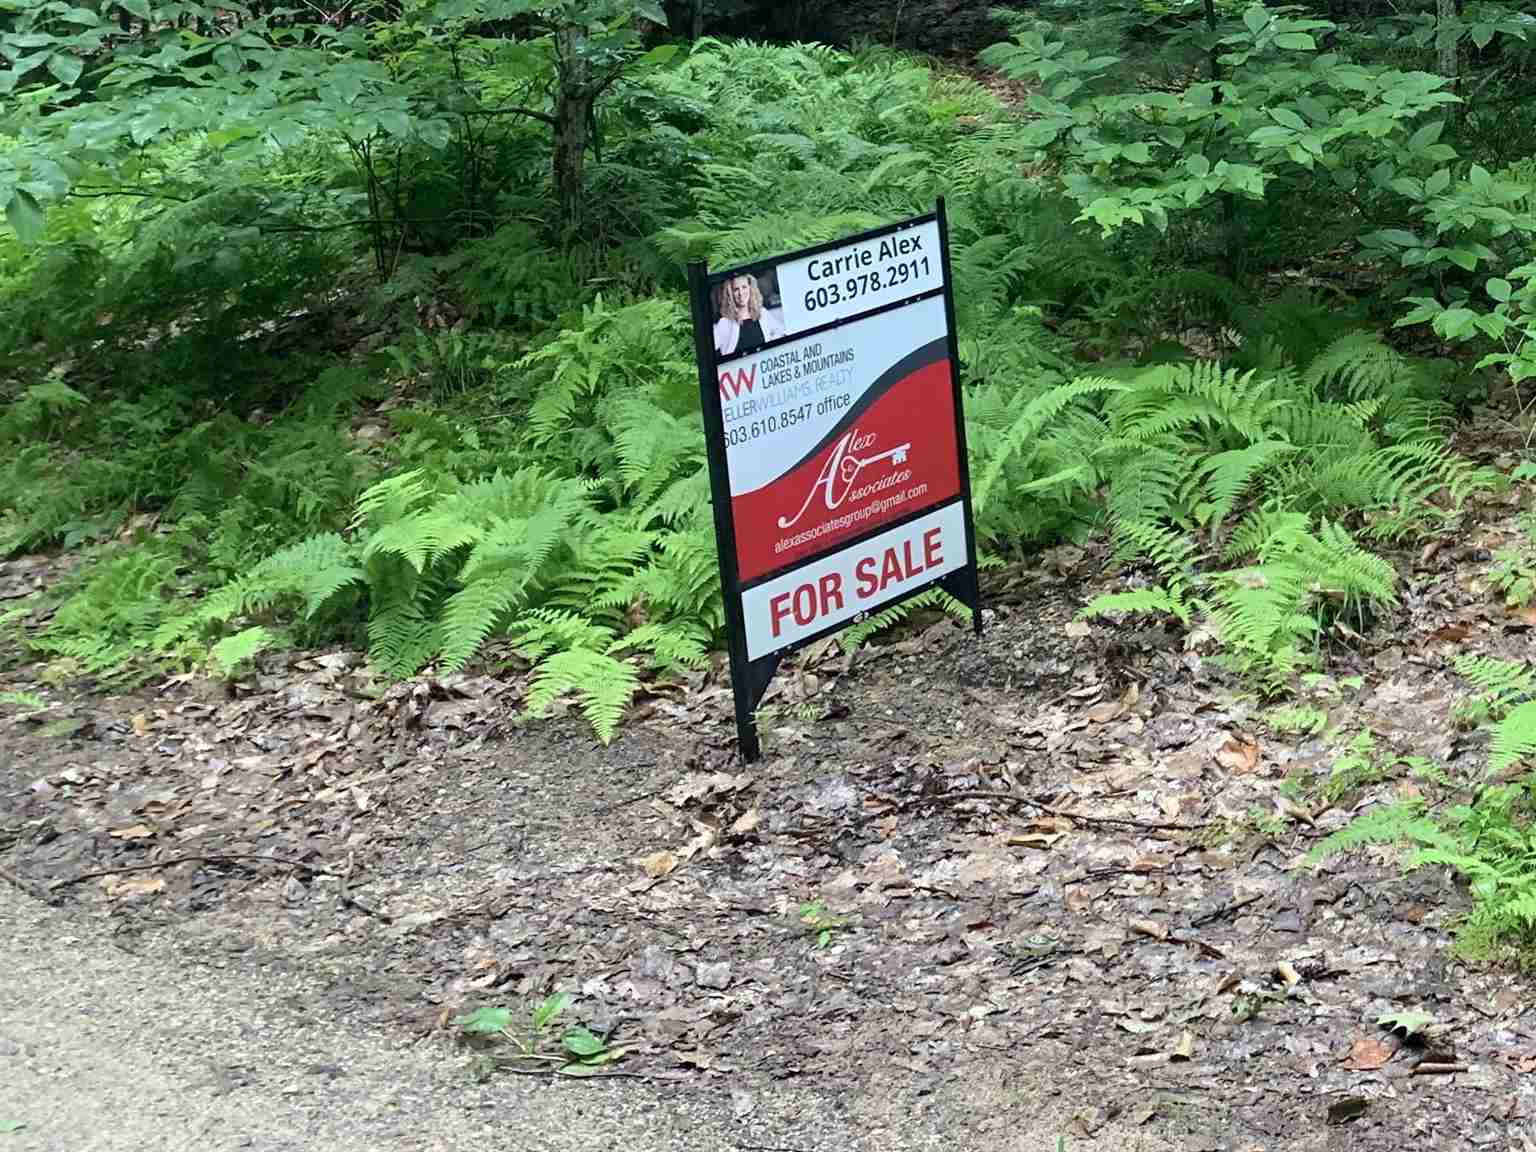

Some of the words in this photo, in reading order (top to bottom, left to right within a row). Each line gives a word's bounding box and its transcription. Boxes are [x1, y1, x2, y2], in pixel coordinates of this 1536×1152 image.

[807, 248, 873, 281] Carrie
[879, 235, 923, 262] Alex
[804, 255, 930, 312] 603.978.2911
[760, 351, 801, 374] COASTAL
[803, 343, 822, 360] AND
[761, 368, 793, 389] LAKES
[794, 366, 801, 379] &
[802, 347, 855, 377] MOUNTAINS
[816, 393, 851, 416] office
[774, 482, 928, 554] alexassociatesgroup@gmail.com
[769, 572, 844, 638] FOR
[855, 527, 944, 599] SALE
